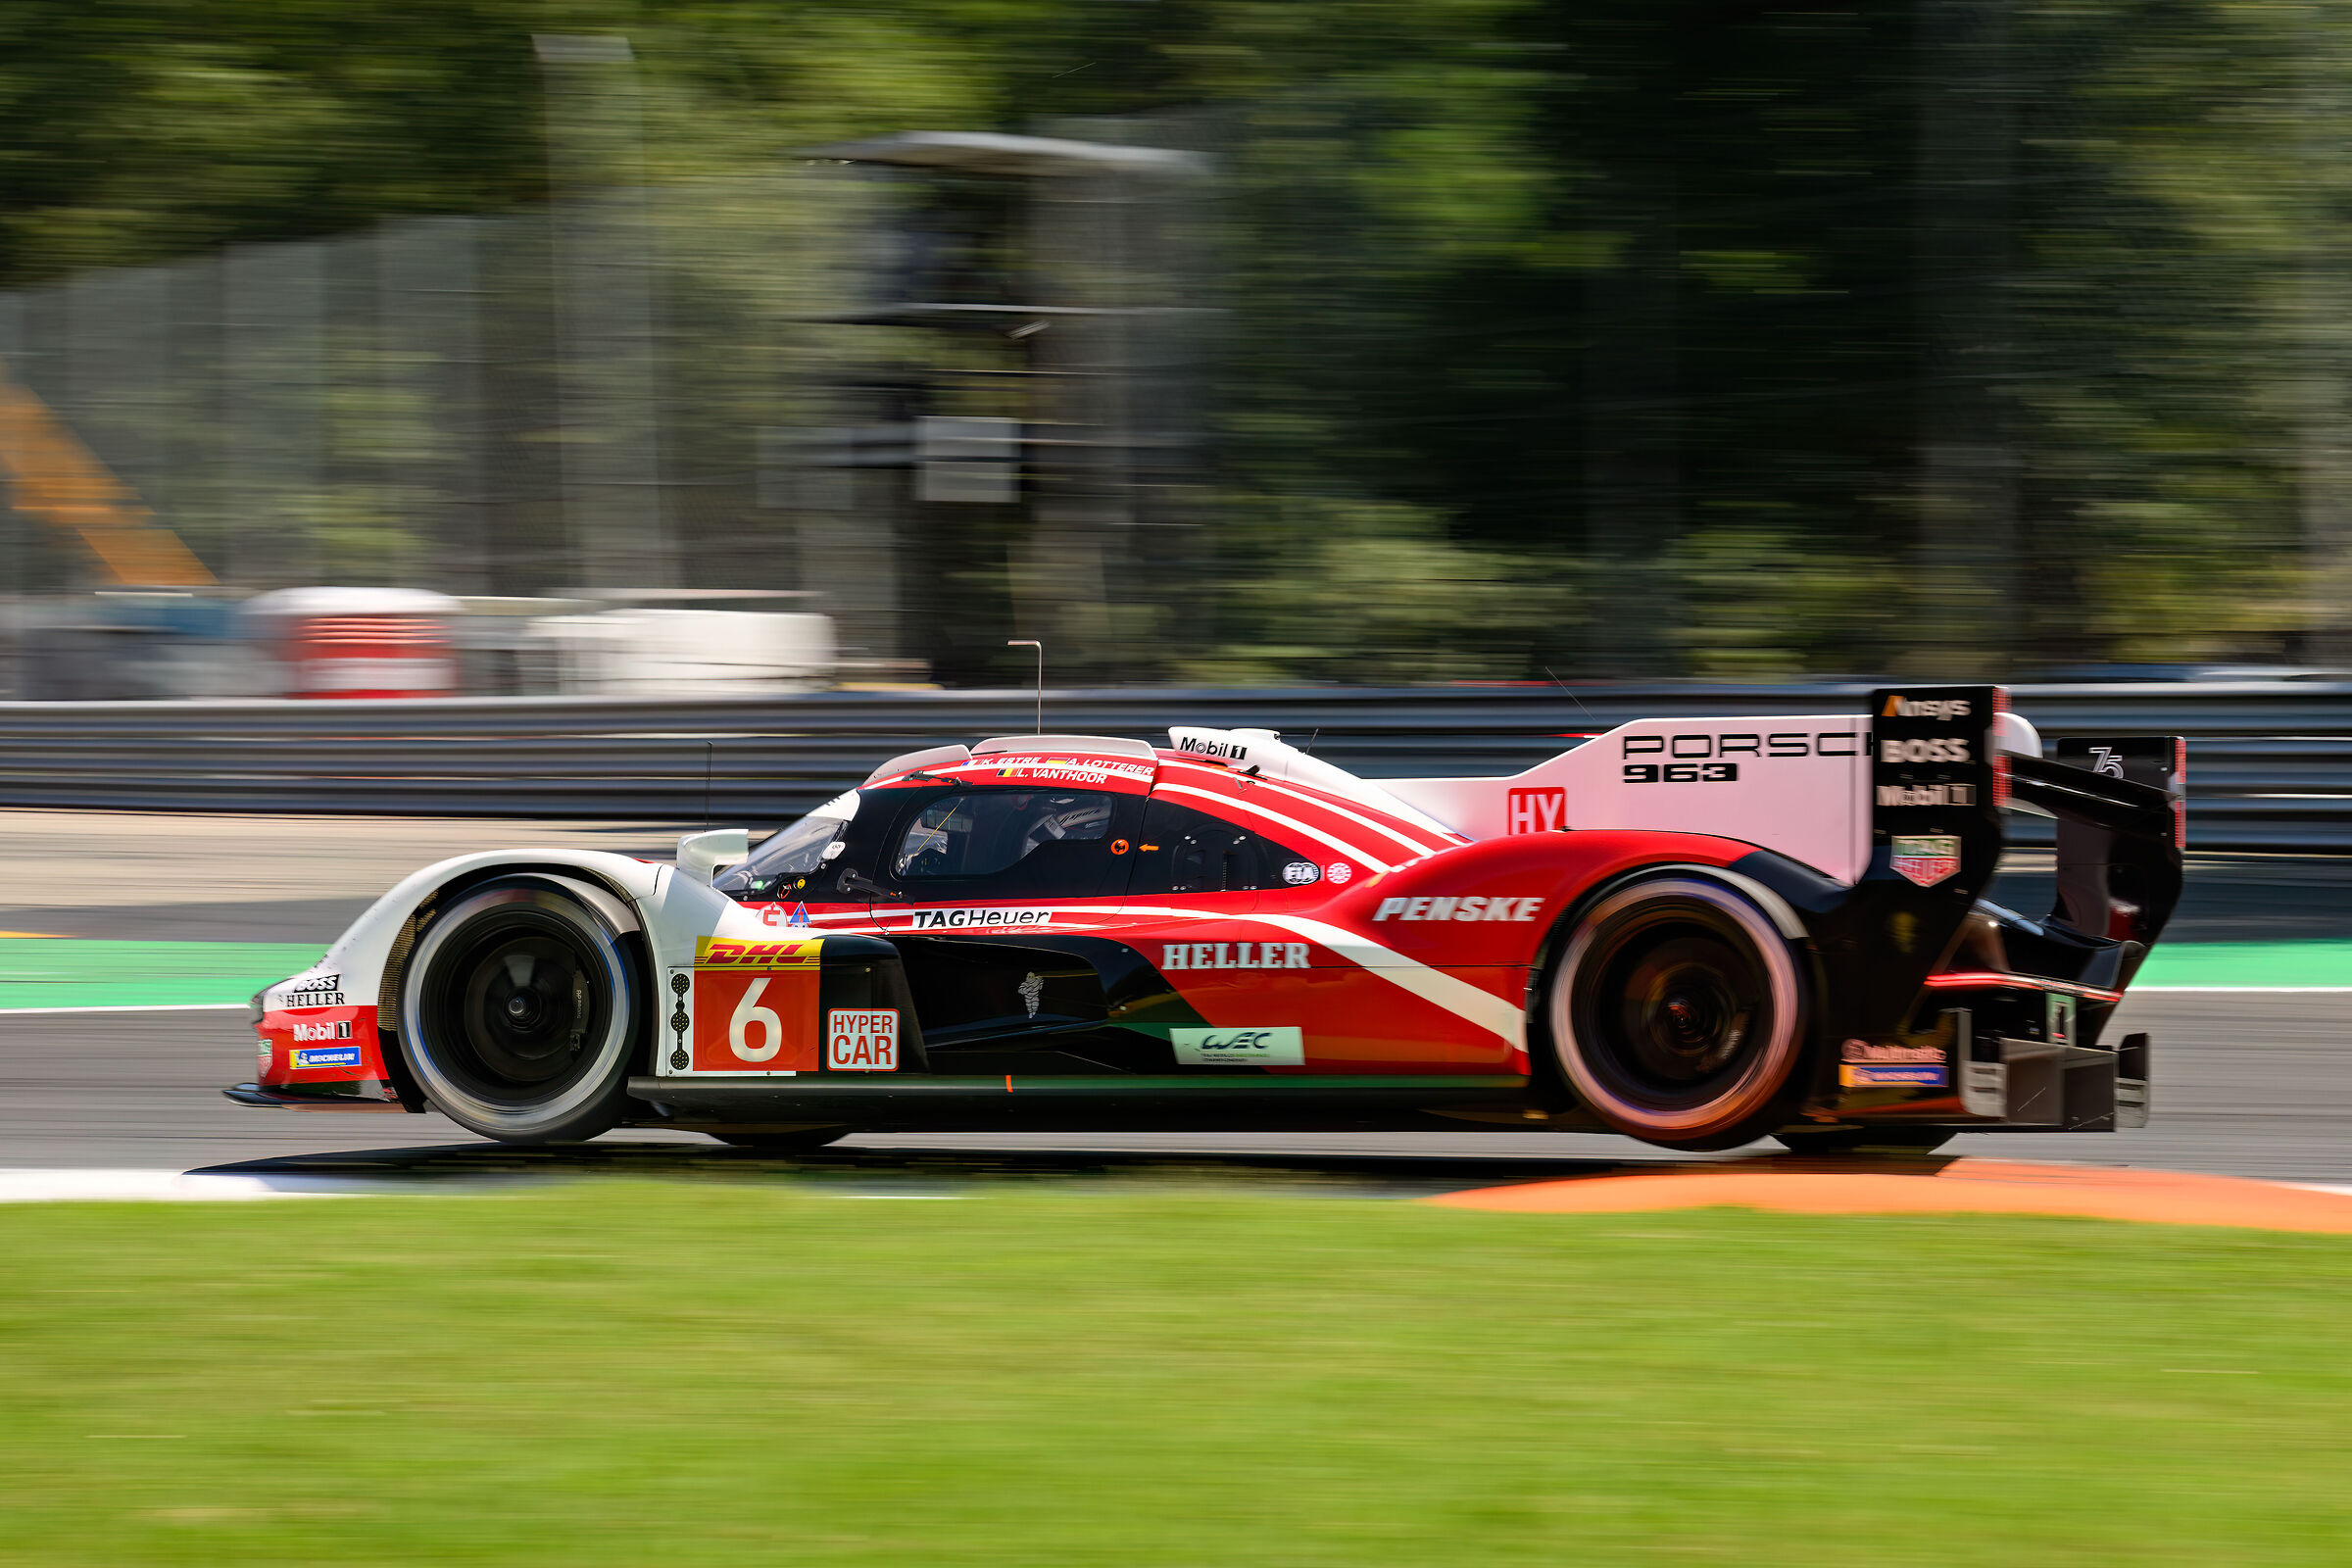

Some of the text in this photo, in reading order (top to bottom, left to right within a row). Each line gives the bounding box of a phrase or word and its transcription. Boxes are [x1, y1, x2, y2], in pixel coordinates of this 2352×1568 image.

[1180, 737, 1229, 757] Mobil
[1622, 732, 1873, 760] PORSC
[1881, 738, 1971, 762] BOSS
[1017, 768, 1107, 784] L. VANTHOOR
[1081, 760, 1154, 775] LOTTERER
[1623, 762, 1738, 783] 963
[1510, 794, 1564, 835] HY
[1372, 896, 1546, 922] PENSKE
[706, 944, 807, 963] DHL
[1161, 943, 1311, 969] HELLER
[286, 992, 345, 1007] HELLER
[729, 977, 782, 1062] 6
[833, 1014, 893, 1033] HYPER
[294, 1022, 335, 1041] Mobil
[1201, 1031, 1273, 1050] WEC
[833, 1035, 892, 1065] CAR
